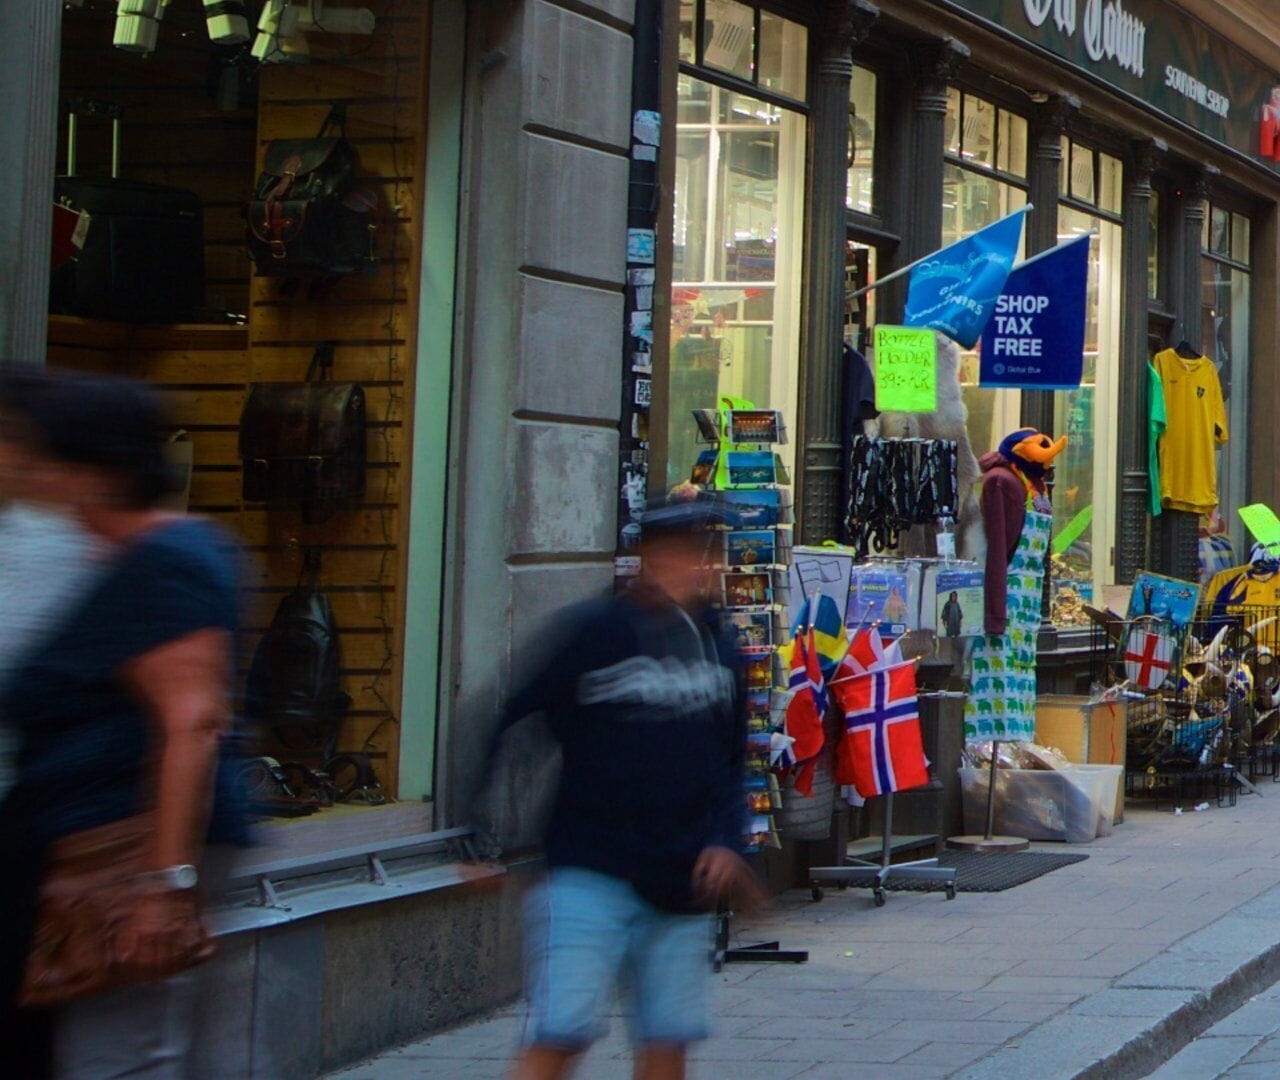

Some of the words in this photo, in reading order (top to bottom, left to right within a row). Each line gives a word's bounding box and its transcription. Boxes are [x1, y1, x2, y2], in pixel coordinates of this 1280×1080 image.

[1165, 65, 1208, 105] SOUVENIR
[994, 295, 1049, 315] SHOP
[994, 316, 1034, 336] TAX
[993, 338, 1043, 358] FREE
